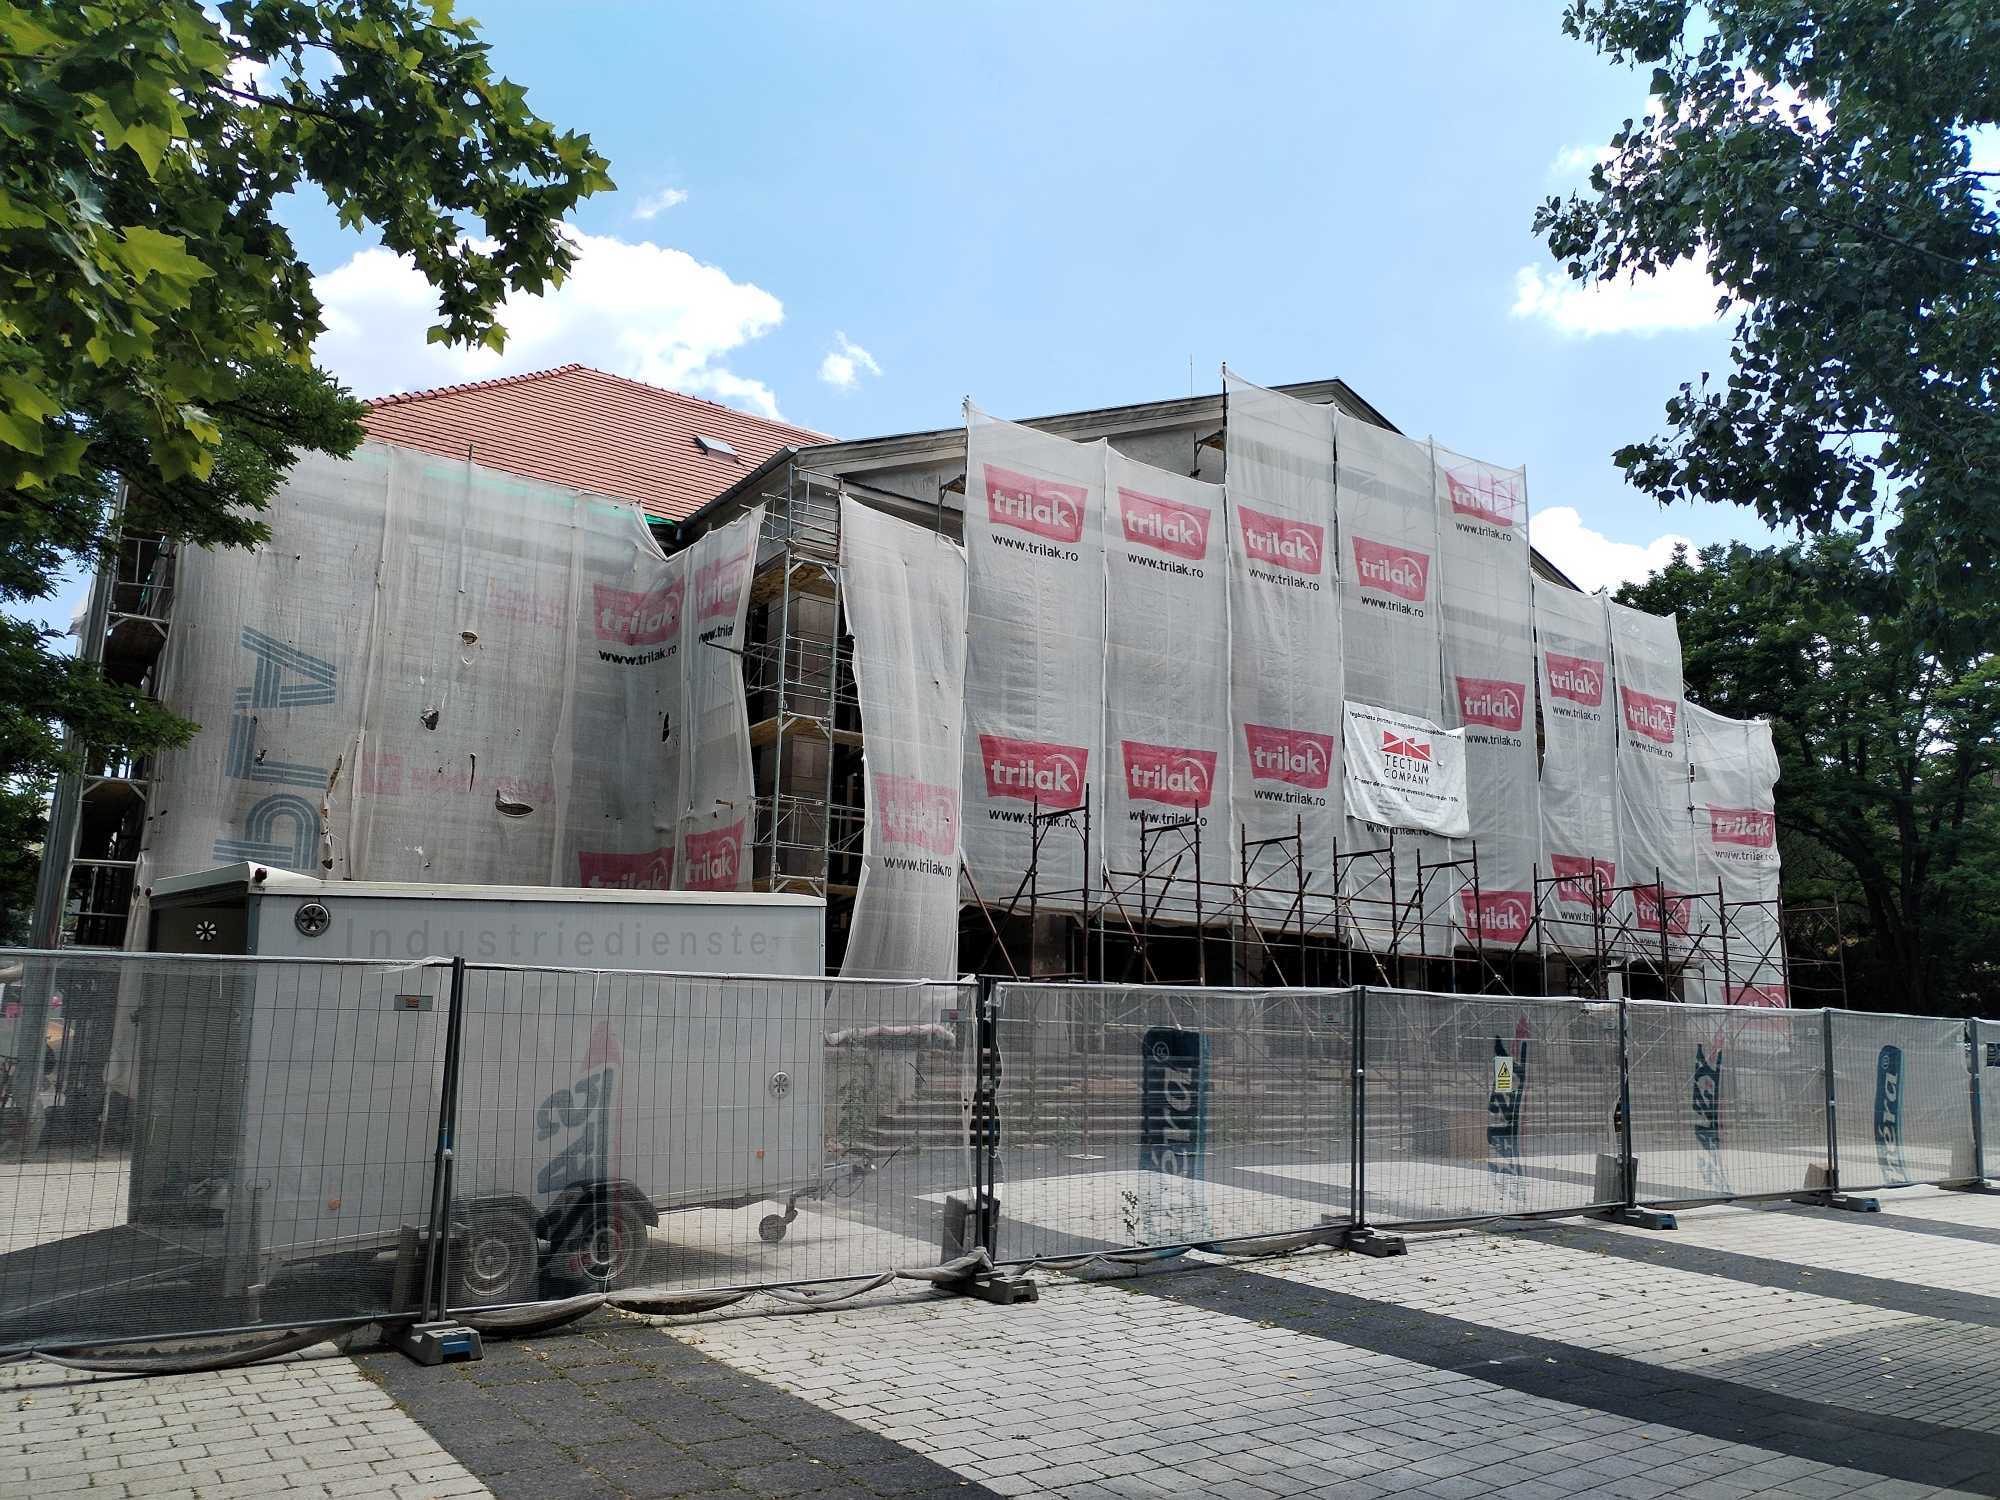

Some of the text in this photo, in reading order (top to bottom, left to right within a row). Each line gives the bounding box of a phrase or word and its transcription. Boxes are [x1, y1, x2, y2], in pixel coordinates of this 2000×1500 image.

[993, 489, 1072, 528] trilak
[1126, 509, 1197, 546] trilak
[1456, 522, 1512, 541] www.trilak.ro
[992, 533, 1078, 562] www.trilak.ro
[1246, 529, 1313, 562] trilak
[1127, 551, 1204, 578] www.trilak.ro
[1360, 557, 1418, 588] trilak
[1248, 567, 1320, 591] www.trilak.ro
[600, 601, 677, 634] trilak
[1361, 595, 1424, 617] www.trilak.ro
[599, 644, 677, 665] www.trilak.ro
[1551, 671, 1597, 695] trilak
[1465, 694, 1516, 719] trilak
[1552, 706, 1600, 721] www.trilak.ro
[1628, 705, 1667, 731] trilak
[1466, 735, 1522, 747] www.trilak.ro
[1254, 745, 1321, 775] trilak
[1385, 754, 1429, 774] TECTUM
[991, 759, 1071, 793] trilak
[1131, 763, 1200, 793] trilak
[1384, 768, 1429, 785] COMPANY
[1254, 788, 1325, 807] www.trilak.ro
[1716, 815, 1769, 837] trilak
[686, 848, 733, 884] trilak
[883, 856, 952, 877] www.trilak.ro
[1469, 906, 1522, 929] trilak
[346, 917, 767, 959] Industriedienste
